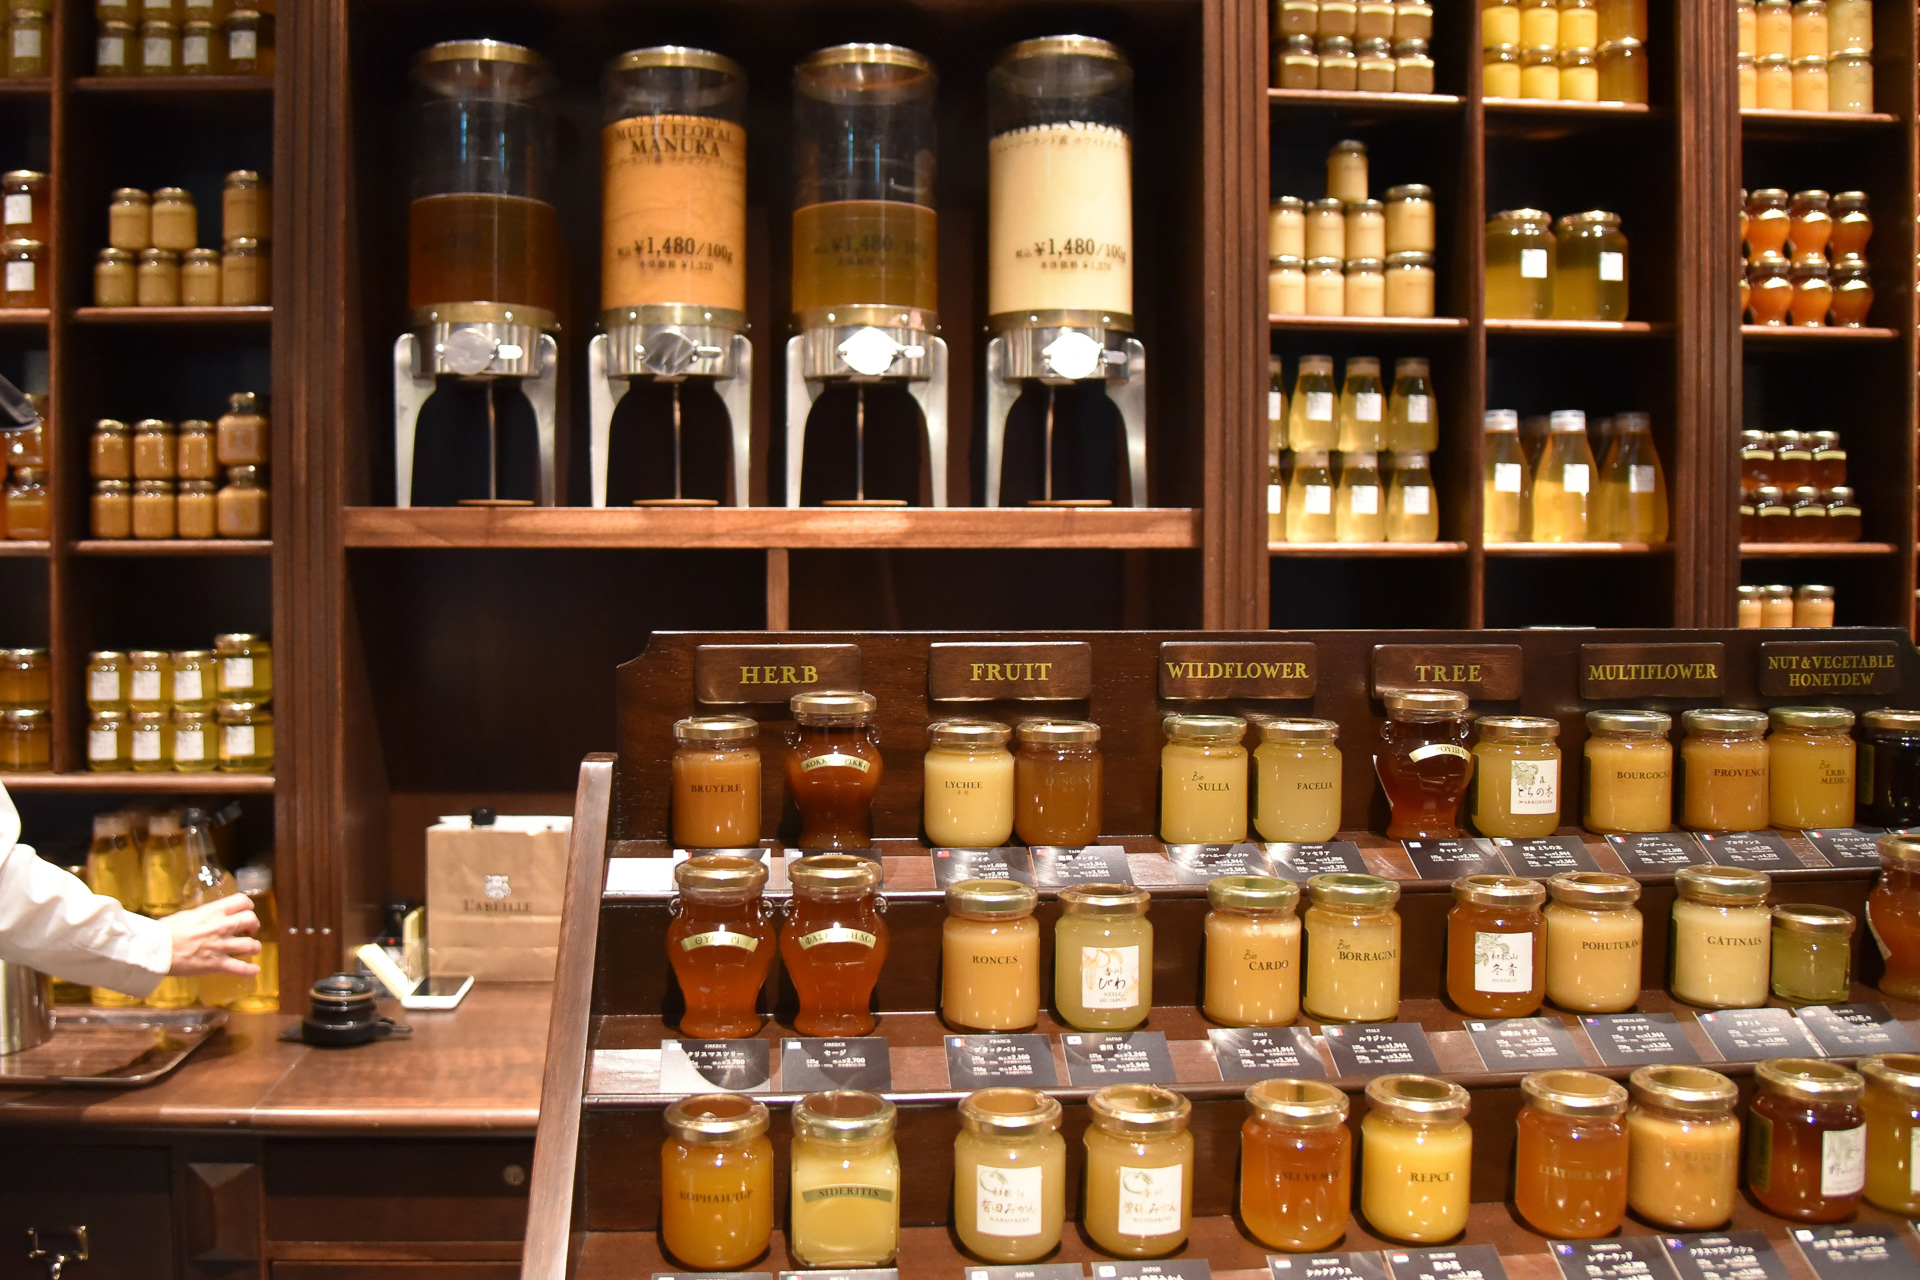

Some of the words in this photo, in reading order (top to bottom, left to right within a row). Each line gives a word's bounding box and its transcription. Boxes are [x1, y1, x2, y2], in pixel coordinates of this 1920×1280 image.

[671, 123, 732, 143] FLORAL
[630, 137, 721, 157] MANUKA
[739, 666, 819, 684] HERB
[970, 662, 1053, 682] FRUIT
[1165, 662, 1310, 680] WILDFLOWER
[1414, 664, 1483, 683] TREE
[1588, 663, 1719, 681] MULTIFLOWER
[1788, 672, 1875, 687] HONEYDEW
[1191, 771, 1204, 782] Bio
[944, 779, 983, 790] LYCHEE
[1197, 782, 1231, 792] SULLA
[463, 898, 533, 913] L'ABEILLE
[694, 935, 740, 945] ΘΥΡΙ
[805, 932, 872, 945] ΦΑΣΗΛΟ
[1336, 939, 1350, 950] Bio
[972, 955, 1018, 965] RONCES
[1243, 950, 1257, 961] Bio
[1249, 960, 1289, 971] CARDO
[1098, 977, 1126, 990] びわ
[818, 1186, 880, 1198] SIDERITIS
